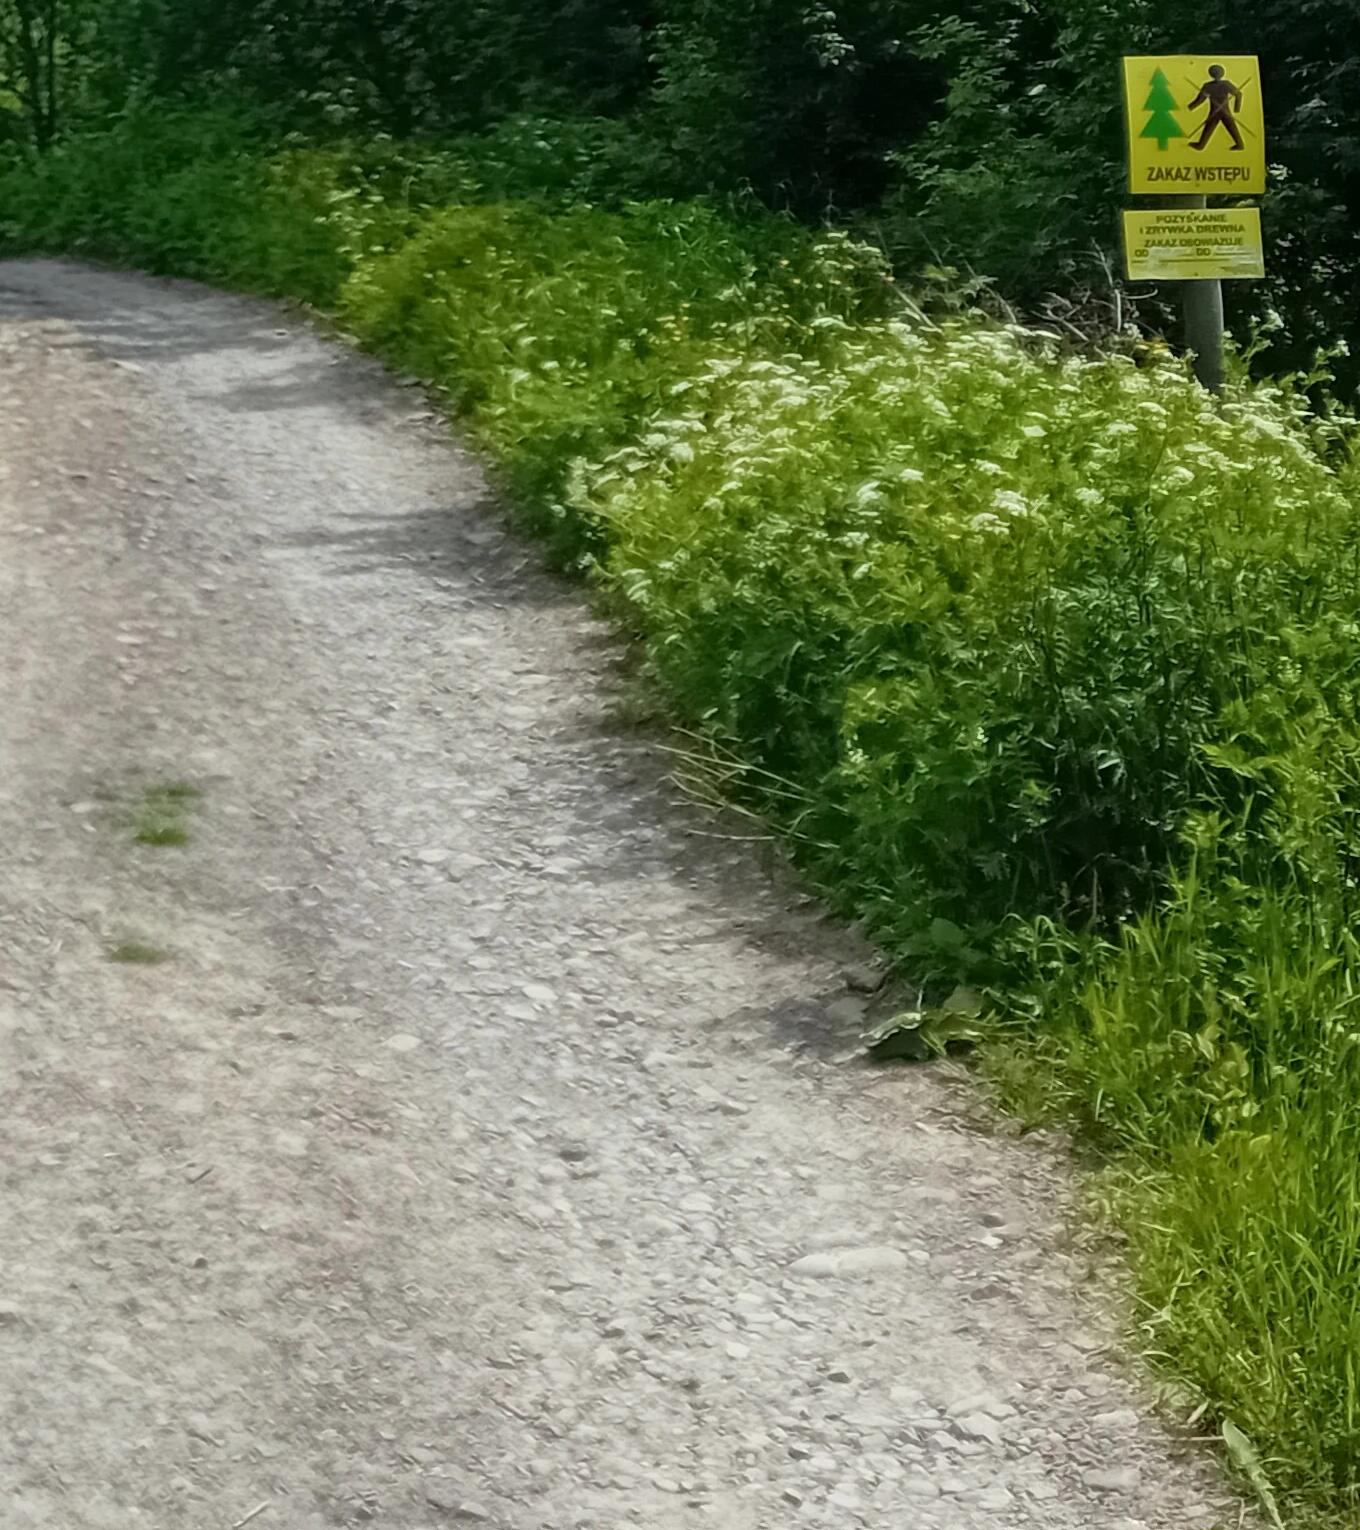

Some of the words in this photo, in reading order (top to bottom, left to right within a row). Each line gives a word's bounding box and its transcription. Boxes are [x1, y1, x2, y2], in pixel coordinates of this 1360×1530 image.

[1147, 166, 1191, 181] ZAKAZ
[1194, 166, 1250, 185] WSTĘPU
[1196, 224, 1246, 233] DREWNA
[1144, 239, 1178, 247] ZAKAZ
[1196, 247, 1211, 256] DO
